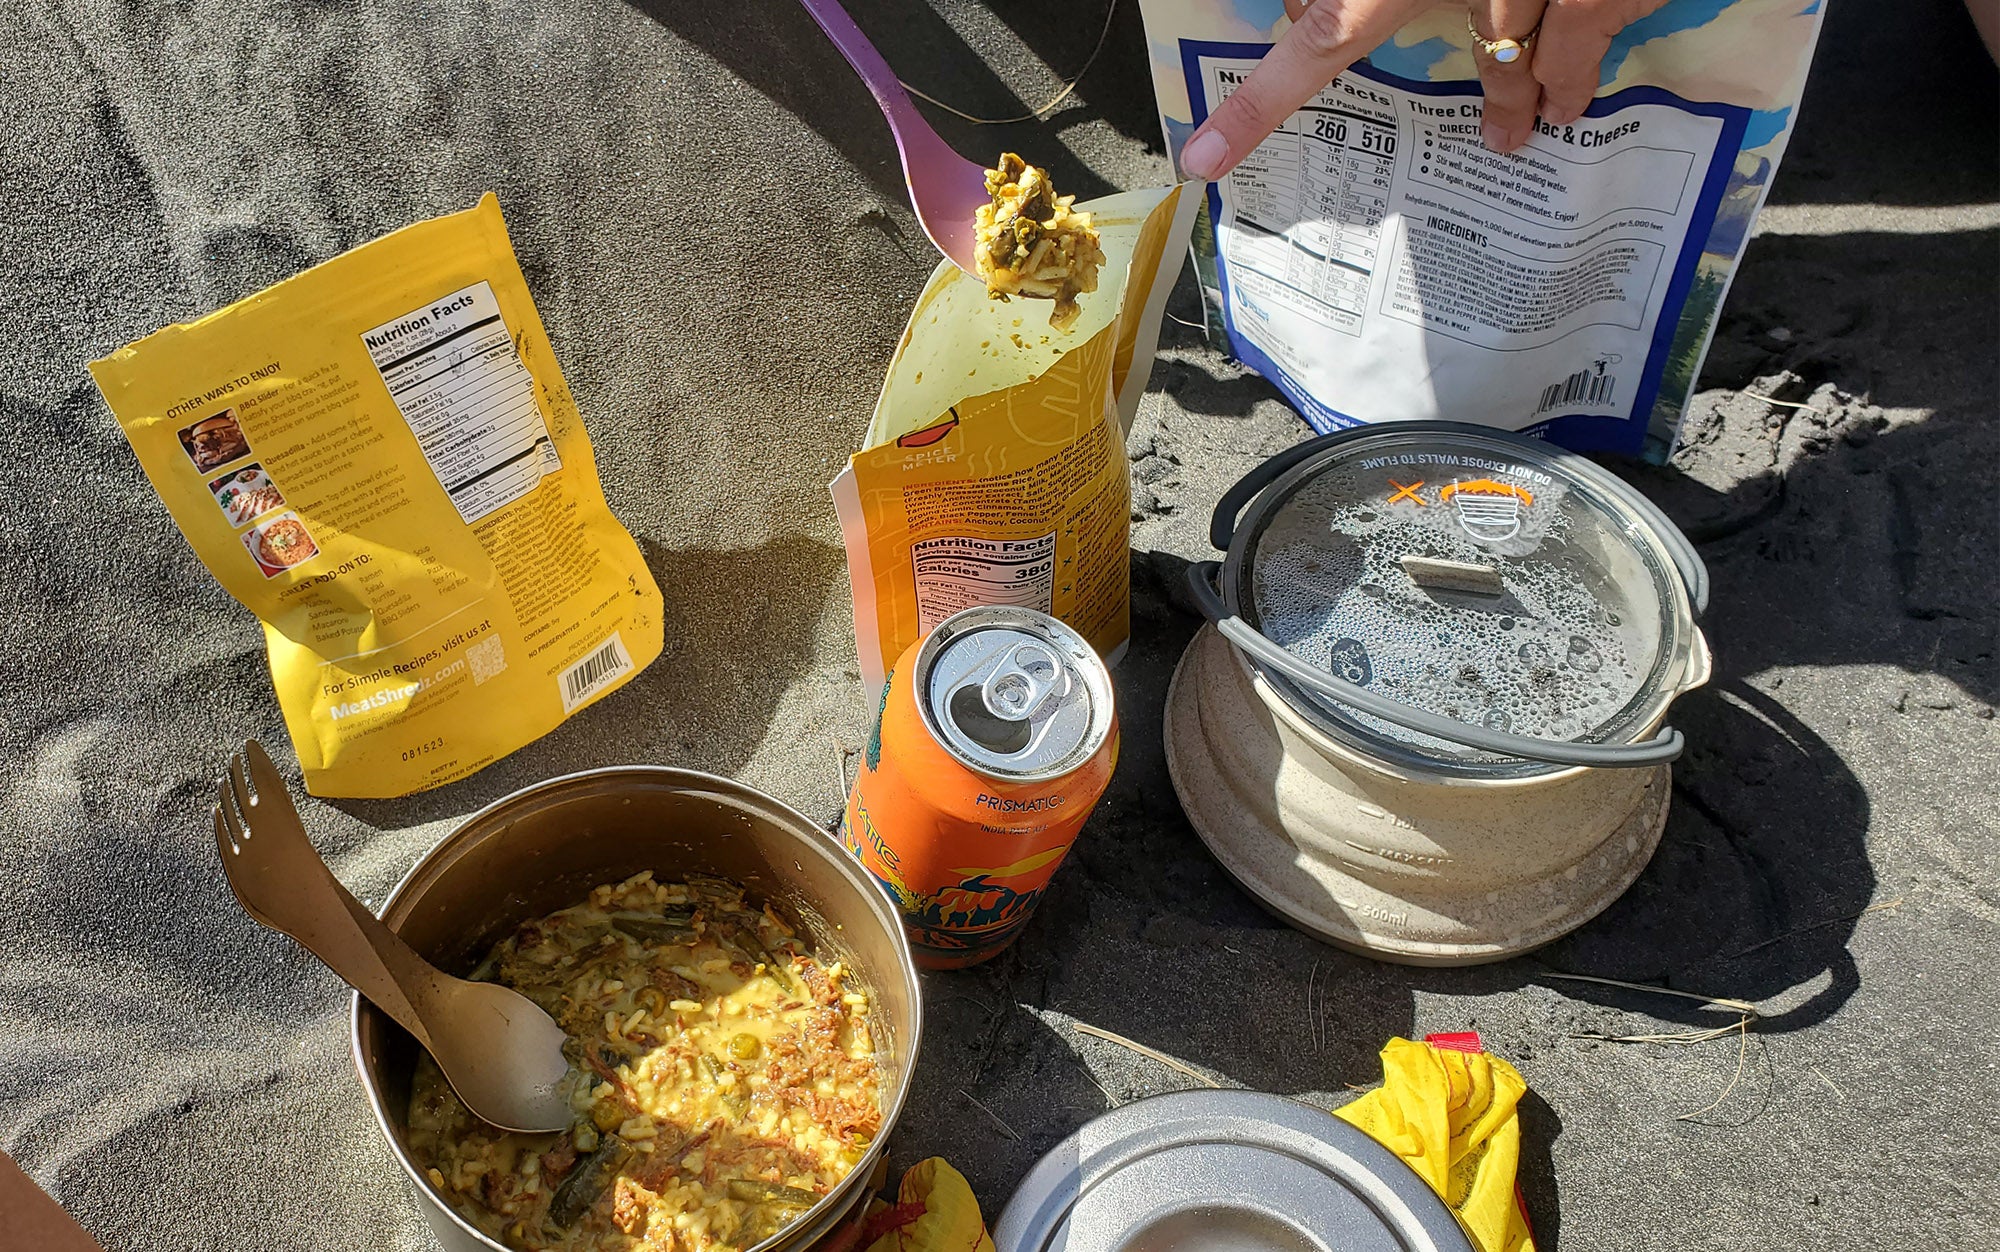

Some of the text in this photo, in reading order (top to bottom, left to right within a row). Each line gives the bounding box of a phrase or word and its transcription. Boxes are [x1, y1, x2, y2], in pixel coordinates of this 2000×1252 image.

[1331, 77, 1391, 105] Facts
[1320, 96, 1396, 123] 1/2 Package (60g)
[1406, 99, 1456, 117] Three
[1312, 118, 1347, 142] 260
[1438, 121, 1482, 136] DIRECTI
[1562, 126, 1577, 144] &
[1579, 120, 1641, 147] Cheese
[1360, 130, 1396, 154] 510
[1466, 137, 1479, 147] and
[1325, 166, 1339, 175] 24%
[1327, 154, 1341, 163] 11%
[1438, 141, 1451, 152] Add
[1467, 151, 1484, 164] cups
[1515, 169, 1523, 177] of
[1523, 171, 1546, 188] boiling
[1546, 181, 1568, 193] water.
[1528, 157, 1559, 175] absorber.
[1372, 177, 1388, 187] 49%
[1374, 166, 1390, 176] 23%
[1435, 153, 1550, 202] Stir well, seal pouch, wait 8 minutes.
[1433, 168, 1445, 179] Stir
[1445, 172, 1465, 186] again,
[1465, 179, 1487, 194] reseal,
[1487, 187, 1501, 199] wait
[1506, 196, 1522, 208] more
[1523, 201, 1553, 218] minutes.
[1554, 210, 1579, 222] Enjoy!
[1427, 215, 1488, 247] INGREDIENTS
[1437, 203, 1449, 211] time
[1484, 221, 1501, 232] 5,000
[1502, 228, 1512, 236] feet
[433, 294, 474, 320] Facts
[367, 315, 430, 350] Nutrition
[372, 326, 435, 358] Serving Size: (28g)
[376, 326, 452, 365] Serving Per Container: About
[166, 362, 283, 420] OTHER WAYS TO ENJOY
[390, 378, 414, 392] Calories
[238, 388, 279, 412] BBQ Slider
[401, 397, 429, 413] Total Fat
[418, 421, 452, 441] Cholesterol
[265, 433, 326, 466] Quesadilla Add
[423, 437, 445, 451] Sodium
[427, 429, 488, 461] Total Carbohydrate
[905, 447, 952, 461] SPICE
[438, 455, 457, 468] Dietary
[902, 455, 956, 471] METER
[979, 473, 1012, 483] (notice
[1015, 466, 1033, 477] how
[1036, 454, 1057, 470] many
[1060, 443, 1074, 457] you
[1076, 433, 1088, 446] can
[1358, 453, 1551, 485] DO NOT EXPOSE WALLS TO FLAME
[445, 474, 468, 488] Protein
[903, 486, 931, 496] Green
[969, 480, 1007, 489] Jasmine
[1011, 475, 1034, 485] Rice,
[1036, 460, 1062, 476] Onion,
[904, 491, 942, 503] (Freshly
[986, 485, 1025, 493] Coconut
[1028, 476, 1048, 489] Milk,
[905, 499, 937, 509] (Water,
[942, 493, 981, 503] Anchovy
[985, 491, 1023, 499] Extract,
[1026, 485, 1045, 497] Salt,
[1047, 469, 1073, 489] Sugar),
[953, 498, 1009, 506] Concentrate
[1012, 486, 1059, 504] (Tamarind,
[907, 509, 938, 522] Ground
[942, 504, 973, 513] Cumin,
[1028, 499, 1051, 510] Dried
[964, 517, 1006, 525] Anchovy,
[1051, 504, 1065, 517] Milk
[473, 511, 515, 535] INGREDIENTS:
[914, 535, 1053, 551] Nutrition Facts
[315, 563, 354, 585] ADD-ON
[354, 553, 373, 567] TO:
[917, 565, 979, 576] Calories
[1014, 561, 1051, 578] 380
[366, 581, 385, 595] Salad
[590, 590, 620, 618] GLUTEN FREE
[527, 650, 538, 659] NO
[538, 623, 581, 653] PRESERVATIVES
[323, 619, 491, 697] For Simple Recipes, visit us at
[331, 661, 465, 720] MeatShredz.com
[401, 738, 444, 761] 081523
[975, 793, 1058, 812] PRISMATIC
[980, 824, 1005, 834] INDIA
[1361, 903, 1408, 927] 500ml
